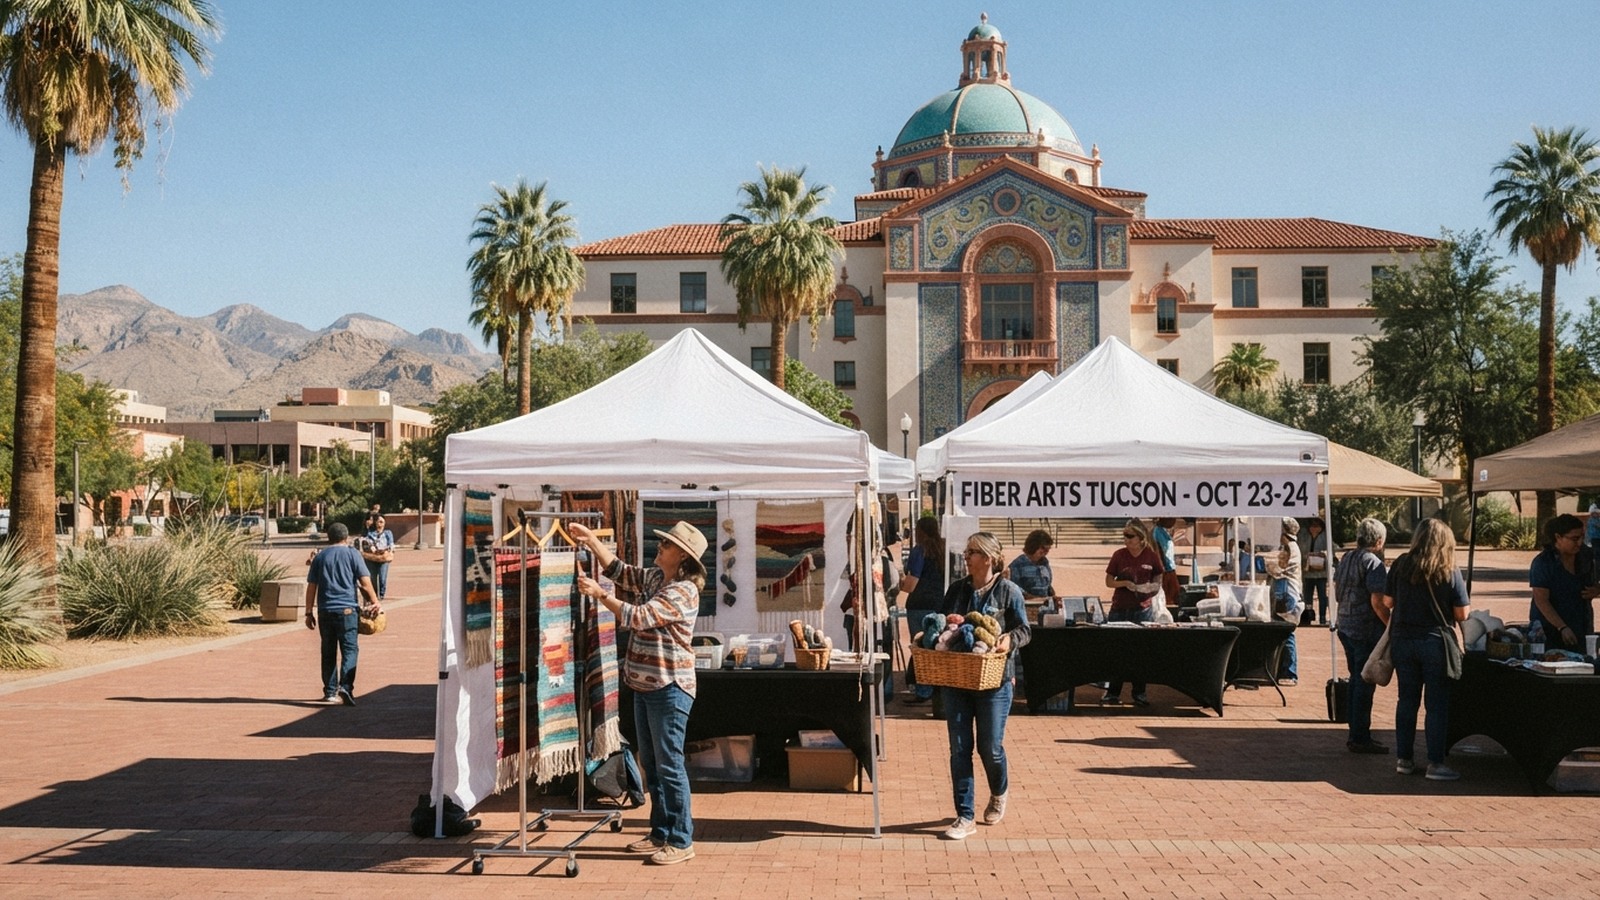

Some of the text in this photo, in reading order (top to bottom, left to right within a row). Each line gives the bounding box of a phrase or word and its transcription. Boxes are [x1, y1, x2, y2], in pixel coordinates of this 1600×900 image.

[961, 481, 1022, 507] FIBER
[1025, 481, 1082, 507] ARTS
[1086, 481, 1177, 508] TUCSON
[1196, 481, 1242, 507] OCT
[1247, 480, 1309, 507] 23-24
